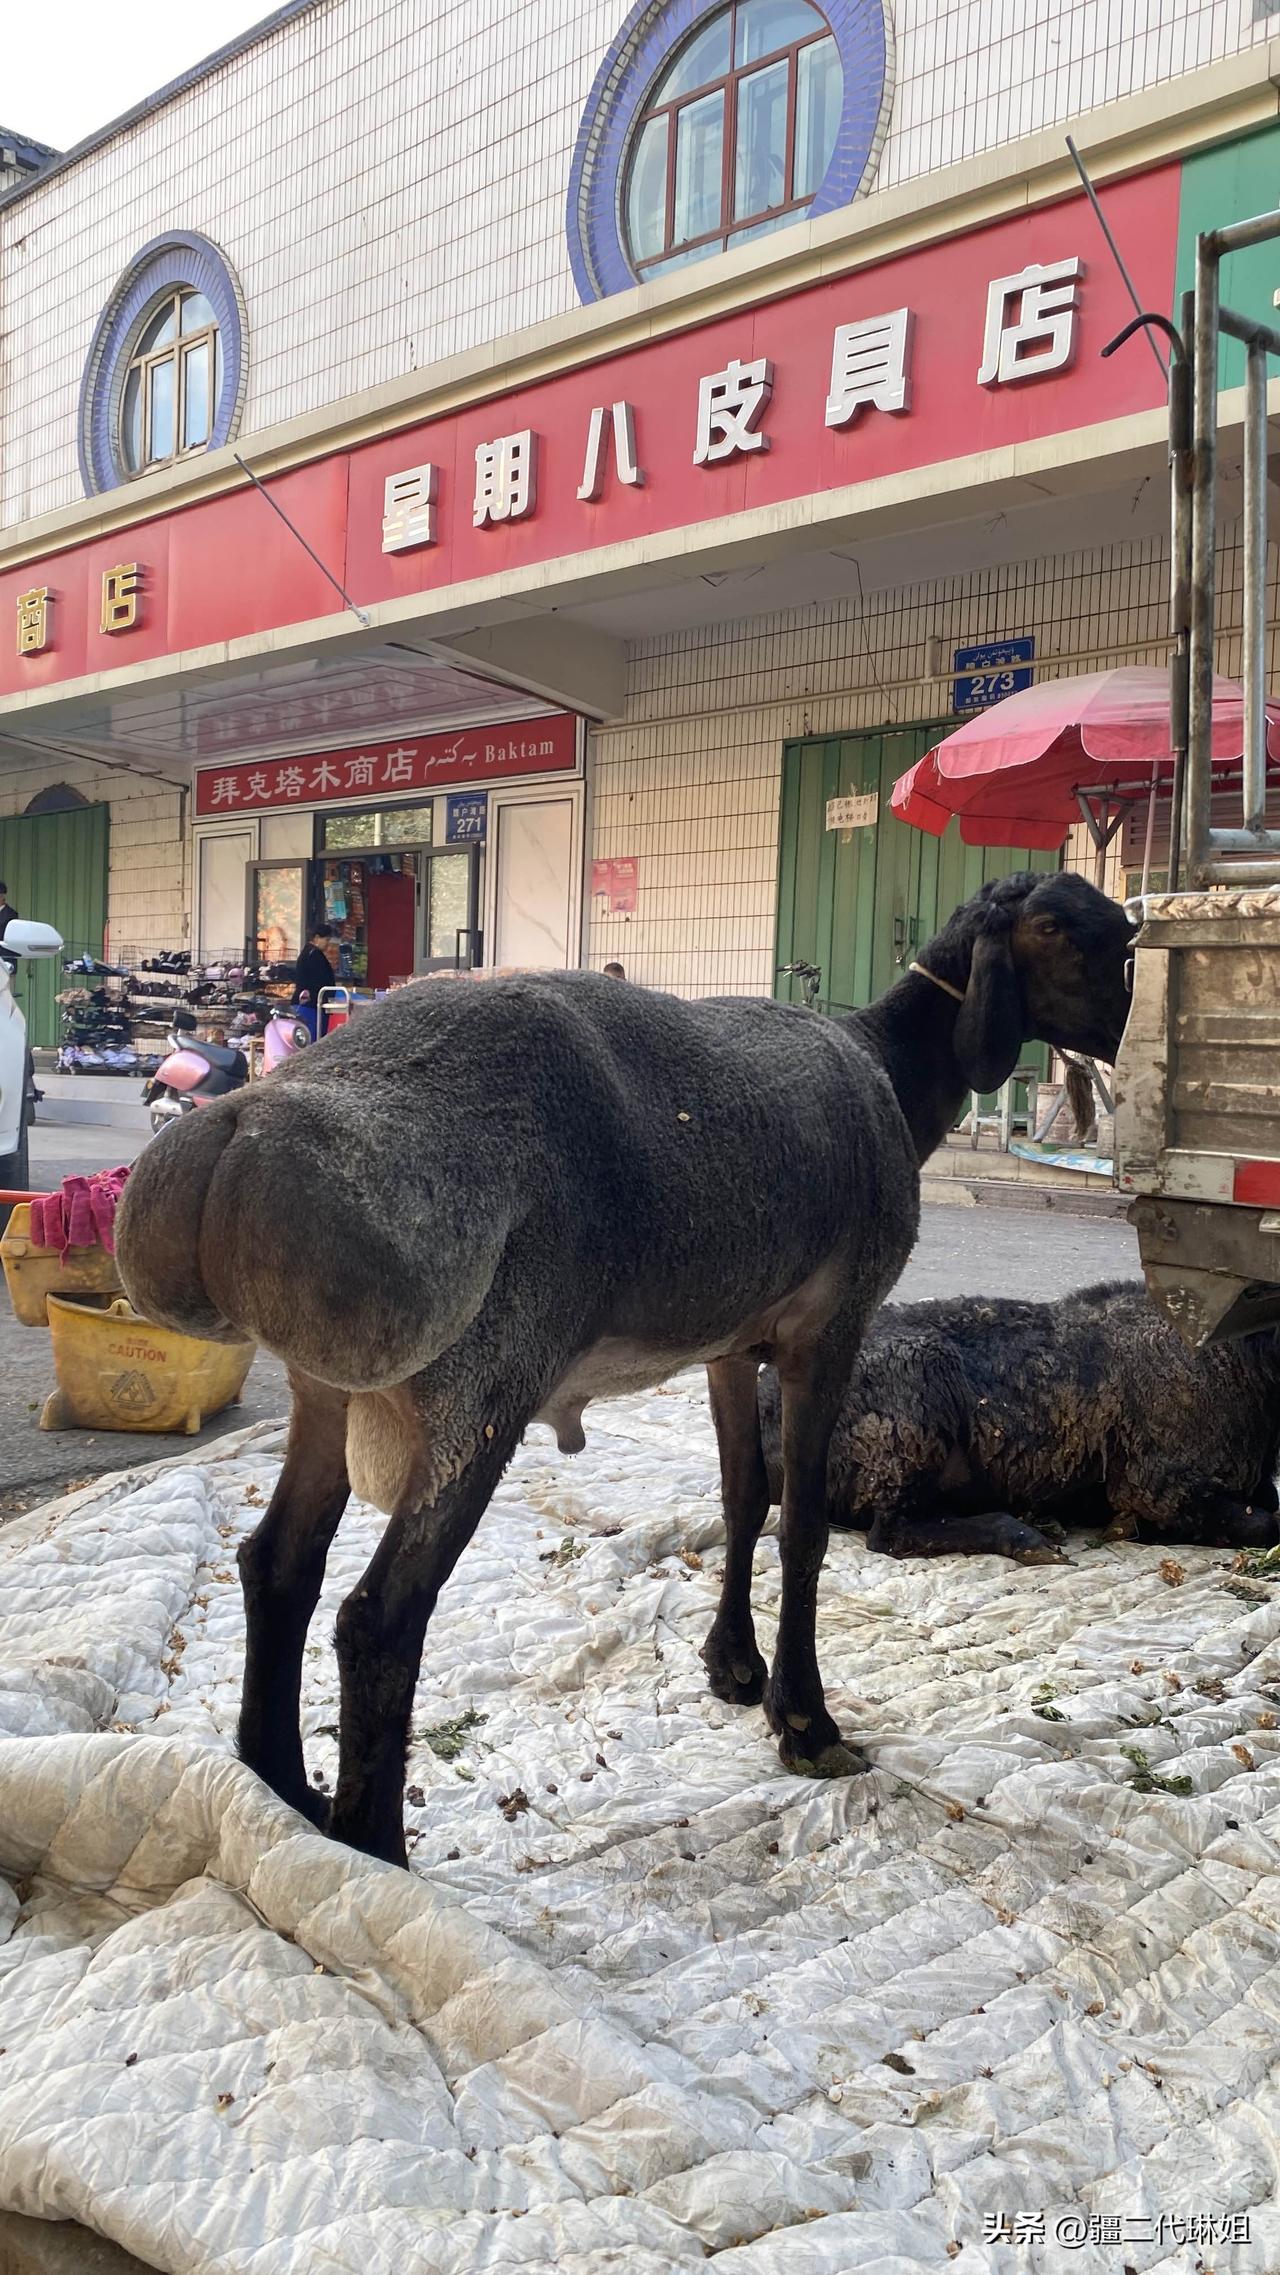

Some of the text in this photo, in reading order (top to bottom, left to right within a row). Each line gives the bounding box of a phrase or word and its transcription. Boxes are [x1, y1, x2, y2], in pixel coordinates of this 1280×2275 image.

[381, 255, 1087, 554] 星期八皮具店
[16, 562, 142, 656] 商店
[970, 671, 1014, 695] 273
[211, 748, 417, 805] 拜克塔木商店
[485, 740, 554, 763] Baktam
[457, 816, 481, 833] 271
[108, 1343, 167, 1362] CAUTION
